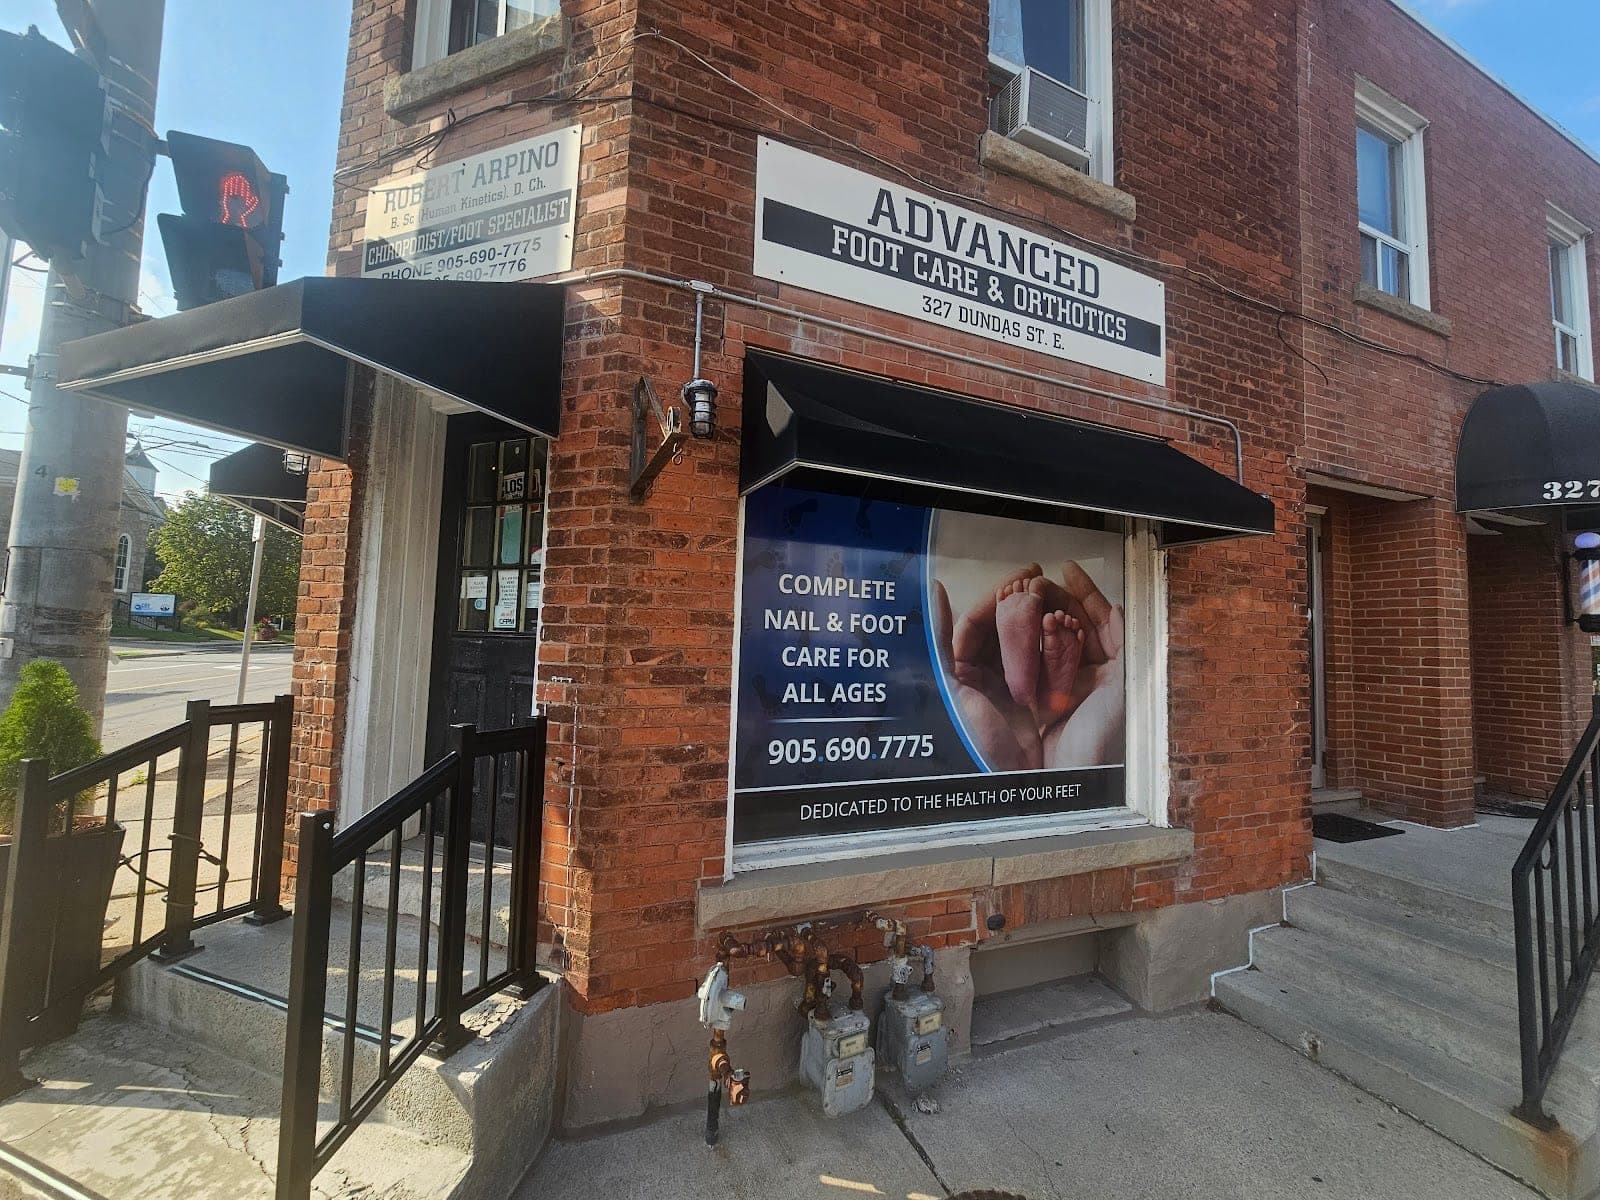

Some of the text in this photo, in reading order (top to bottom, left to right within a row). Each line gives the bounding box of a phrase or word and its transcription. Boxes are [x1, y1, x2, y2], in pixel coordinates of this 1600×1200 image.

[384, 141, 560, 214] ROBERT ARPINO
[391, 217, 399, 229] B.
[514, 182, 523, 196] D.
[529, 177, 546, 191] Ch.
[487, 197, 568, 236] SPECIALIST
[382, 237, 542, 279] PHONE 905-690-7775
[867, 188, 1100, 299] ADVANCED
[427, 258, 527, 281] 690-7776
[832, 225, 1127, 342] FOOT CARE & ORTHOTICS
[922, 295, 1065, 350] 327 DUNDAS ST. E.
[35, 465, 48, 478] 4
[1543, 480, 1600, 500] 327
[779, 573, 896, 600] COMPLETE
[764, 609, 906, 634] NAIL & FOOT
[782, 646, 890, 668] CARE FOR
[782, 683, 886, 703] ALL AGES
[768, 735, 934, 765] 905.690.7775
[800, 784, 1082, 820] DEDICATED TO THE HEALTH OF YOUR FEET
